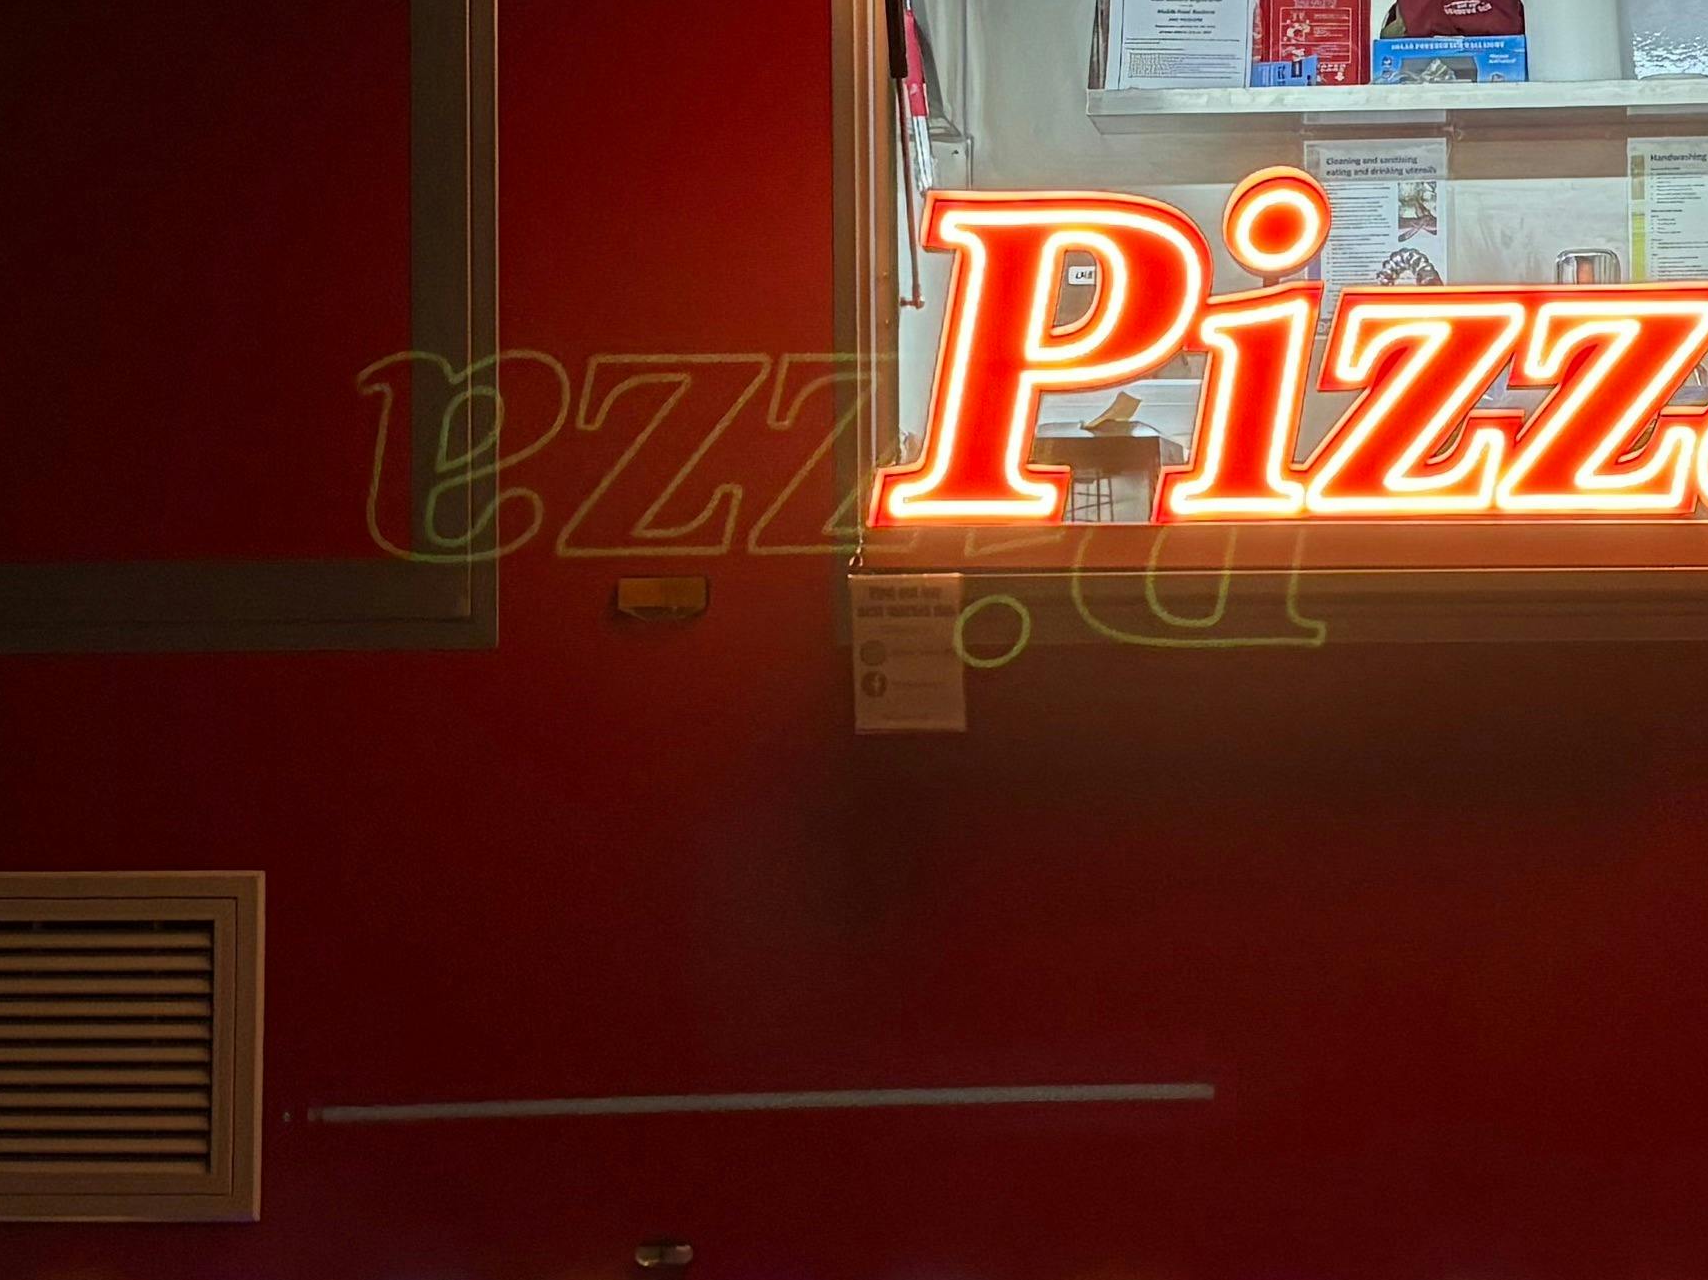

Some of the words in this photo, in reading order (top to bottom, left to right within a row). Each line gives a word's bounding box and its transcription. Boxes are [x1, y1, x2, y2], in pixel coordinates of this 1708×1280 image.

[1326, 156, 1361, 167] Cleaning
[1362, 156, 1378, 165] and
[1650, 152, 1708, 162] Handwashing
[1326, 168, 1352, 177] eating
[1353, 167, 1369, 176] and
[1370, 166, 1404, 177] drinking
